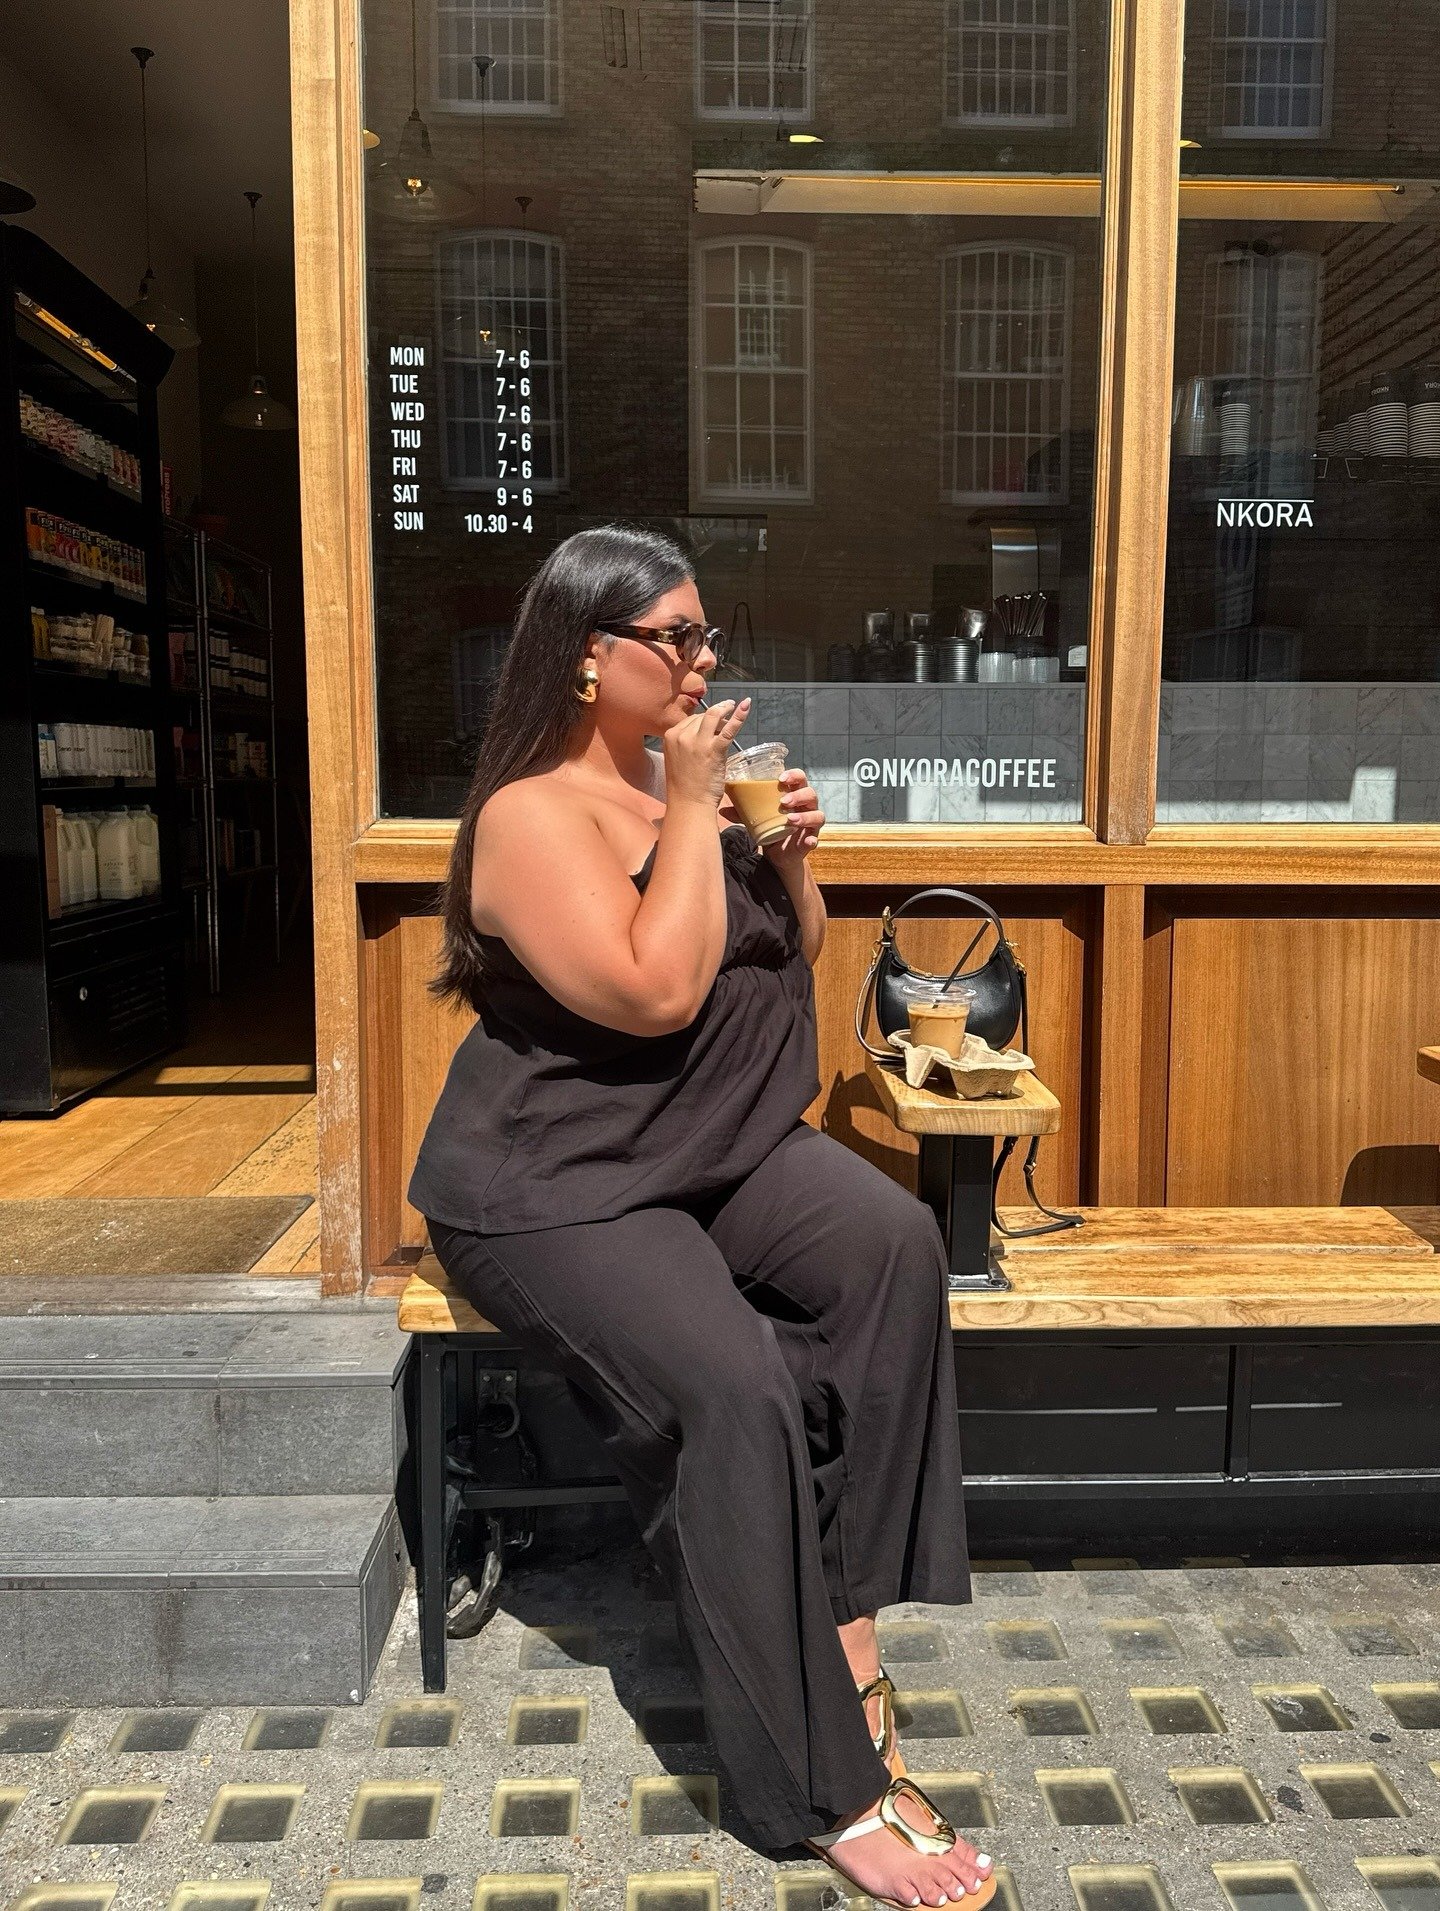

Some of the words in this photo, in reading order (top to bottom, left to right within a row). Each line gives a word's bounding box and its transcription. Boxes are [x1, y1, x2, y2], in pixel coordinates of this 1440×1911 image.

[391, 347, 424, 366] MON
[496, 350, 505, 368] 7
[520, 350, 529, 369] 6
[390, 374, 418, 393] TUE
[496, 378, 505, 396] 7
[521, 378, 530, 396] 6
[391, 402, 424, 421] WED
[497, 405, 506, 423] 7
[521, 406, 530, 424] 6
[391, 430, 421, 448] THU
[498, 433, 507, 451] 7
[522, 433, 531, 451] 6
[393, 457, 416, 476] FRI
[498, 460, 507, 479] 7
[522, 461, 531, 479] 6
[393, 484, 419, 503] SAT
[497, 487, 507, 506] 9
[523, 488, 532, 506] 6
[394, 512, 423, 530] SUN
[465, 514, 507, 533] 10.30
[523, 515, 533, 533] 4
[1217, 502, 1314, 528] NKORA
[853, 758, 1057, 788] @NKORACOFFEE
